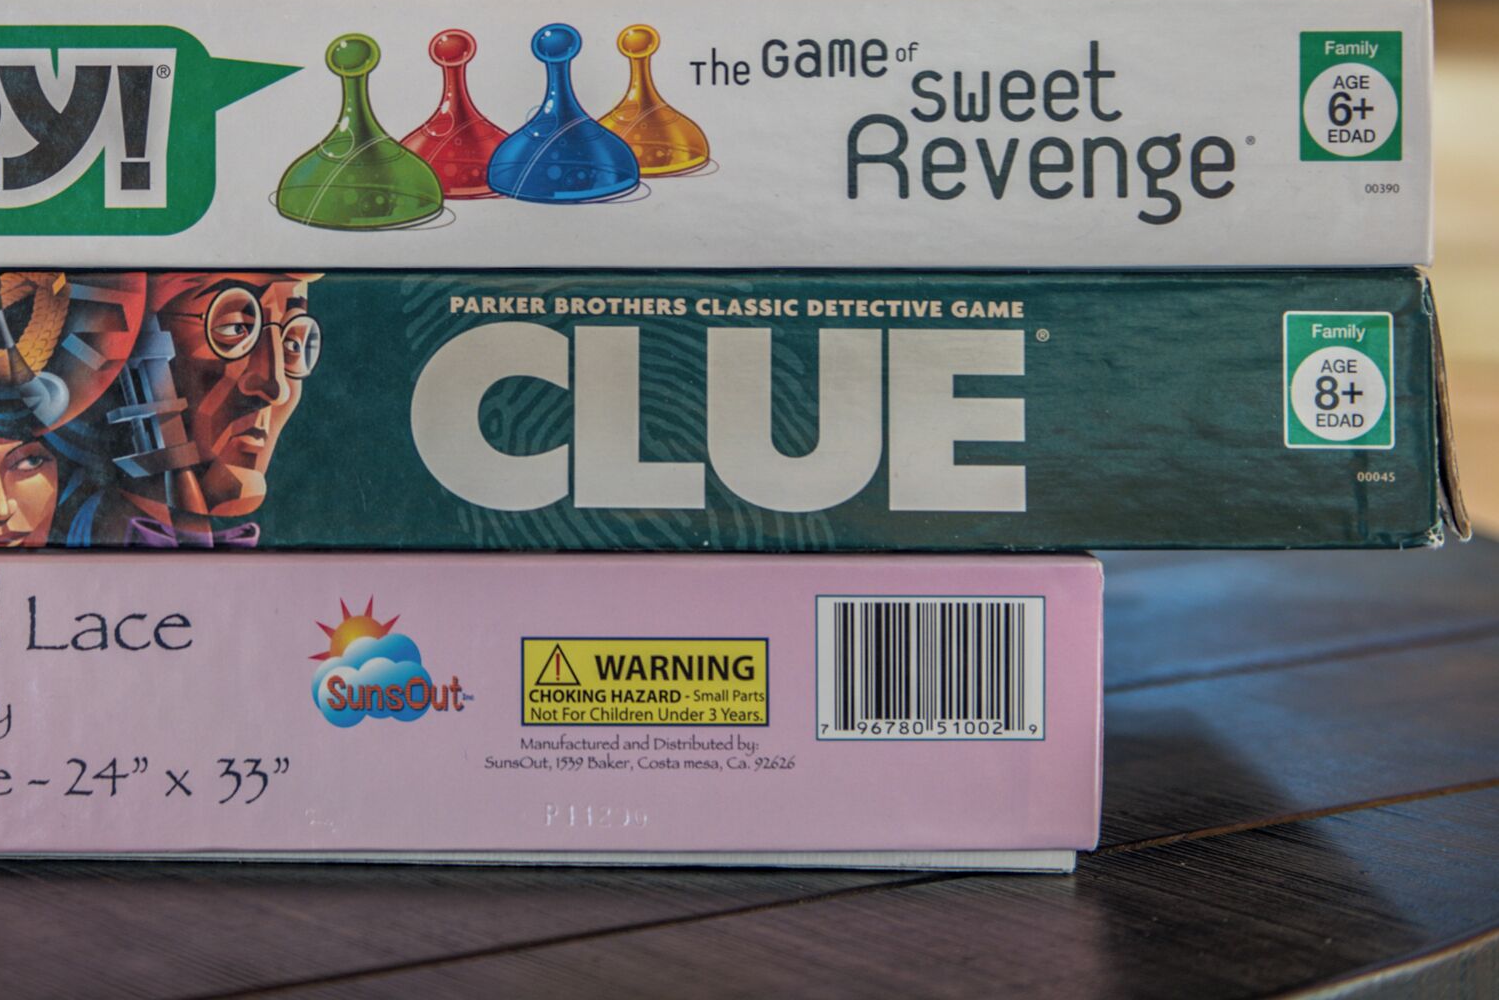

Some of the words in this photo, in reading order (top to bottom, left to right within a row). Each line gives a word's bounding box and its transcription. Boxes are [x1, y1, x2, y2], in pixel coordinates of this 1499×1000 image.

[1324, 41, 1378, 58] Family
[690, 48, 750, 85] The
[761, 38, 889, 79] Game
[896, 43, 919, 63] of
[1333, 76, 1370, 89] AGE
[1328, 92, 1374, 126] 6+
[1327, 130, 1376, 143] EDAD
[847, 113, 1236, 225] Revenge
[1365, 184, 1400, 193] 00390
[450, 297, 545, 314] PARKER
[555, 298, 687, 315] BROTHERS
[696, 299, 799, 317] CLASSIC
[807, 300, 943, 318] DETECTIVE
[952, 301, 1025, 319] GAME
[1312, 324, 1366, 341] Family
[1321, 359, 1358, 373] AGE
[1315, 375, 1363, 410] 8+
[411, 320, 1027, 513] CLUE
[1316, 413, 1364, 427] EDAD
[1357, 471, 1396, 482] 00045
[27, 595, 193, 651] Lace
[594, 655, 756, 681] WARNING
[326, 674, 465, 712] SunsOut
[529, 689, 606, 703] CHOKING
[611, 689, 681, 703] HAZARD
[693, 689, 729, 702] Small
[733, 689, 765, 702] Parts
[530, 707, 557, 721] Not
[562, 707, 586, 721] For
[590, 706, 653, 721] Children
[658, 706, 705, 721] Under
[709, 708, 717, 721] 3
[721, 708, 763, 721] Years.
[821, 724, 829, 734] 7
[857, 721, 924, 735] 96780
[937, 721, 1003, 735] 51002
[1029, 724, 1038, 734] 9
[520, 734, 619, 750] Manufactured
[623, 735, 649, 750] and
[653, 735, 734, 751] Distributed
[737, 736, 759, 756] by:
[484, 757, 552, 771] SunsOut,
[588, 753, 633, 771] Baker,
[637, 757, 680, 770] Costa
[684, 759, 723, 771] mesa,
[726, 757, 750, 770] Ca.
[754, 757, 796, 770] 92626
[165, 770, 193, 797] x
